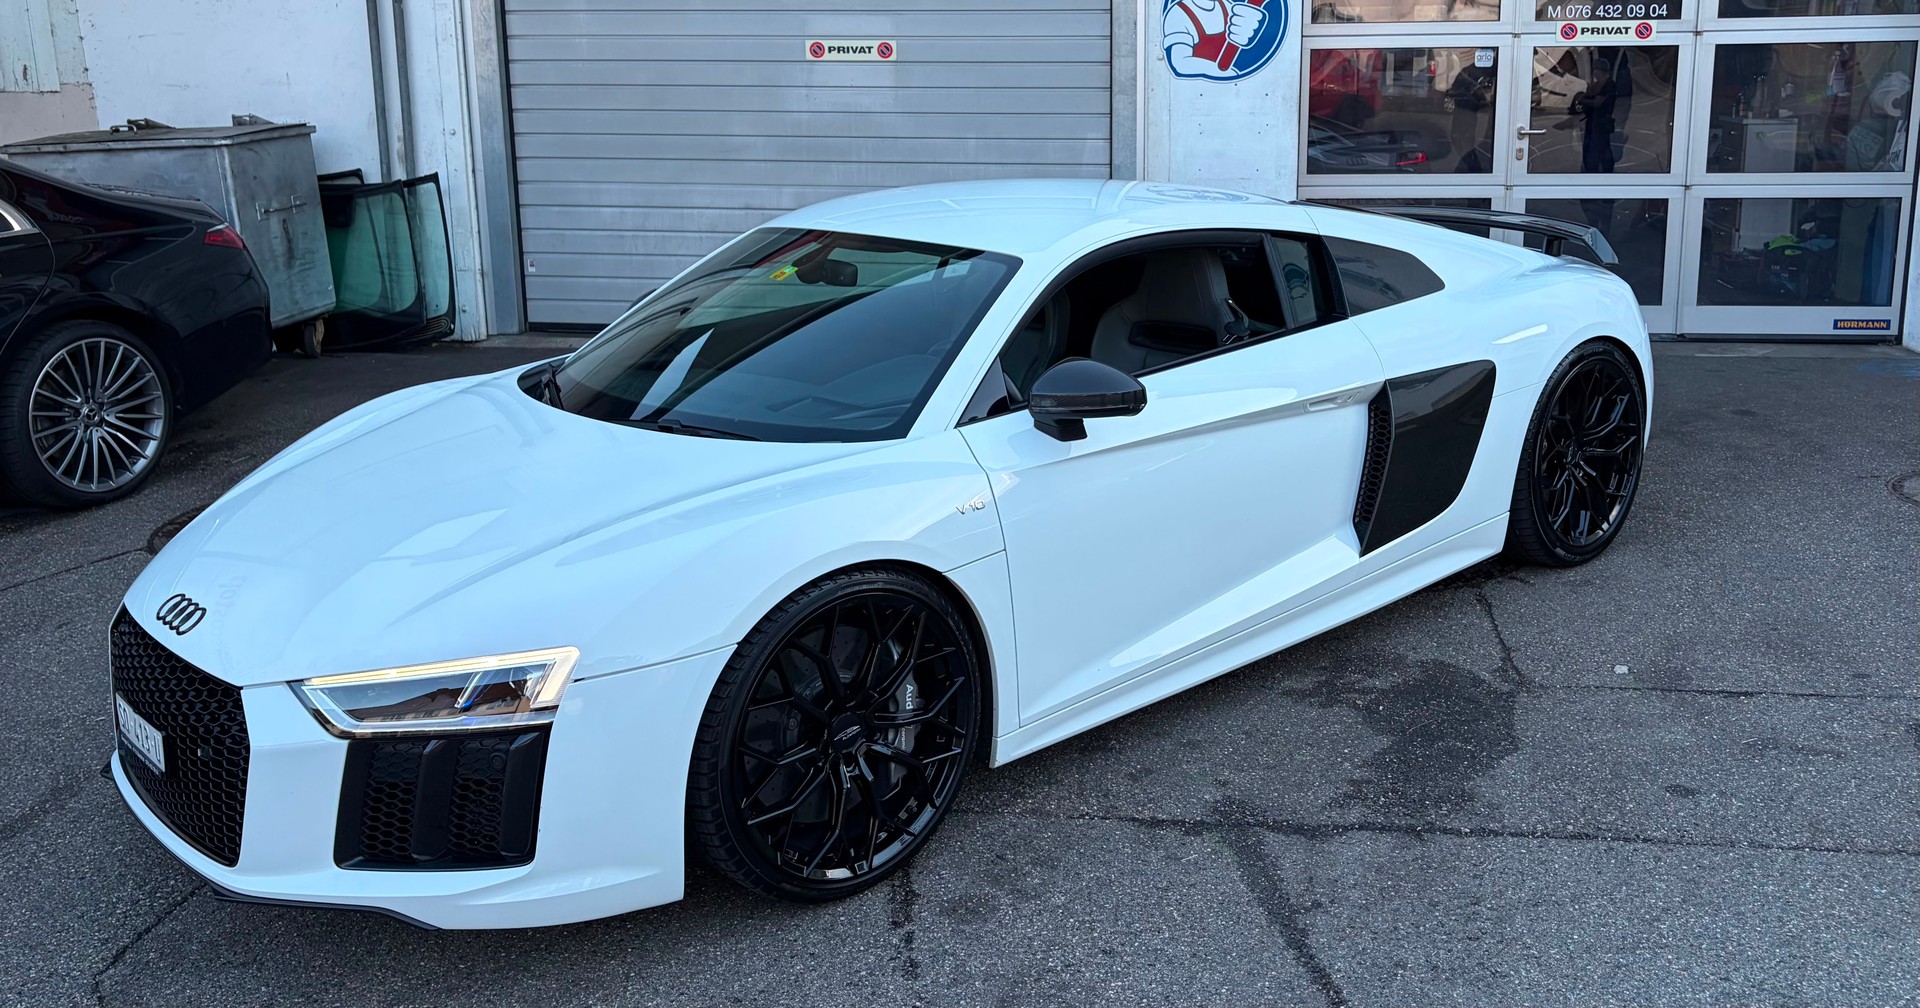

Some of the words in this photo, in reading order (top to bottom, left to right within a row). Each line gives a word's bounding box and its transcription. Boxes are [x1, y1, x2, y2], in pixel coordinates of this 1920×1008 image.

[1547, 5, 1561, 18] M
[1565, 5, 1592, 18] 076
[1595, 4, 1622, 18] 432
[1626, 4, 1645, 17] 09
[1649, 4, 1668, 17] 04
[1580, 26, 1631, 35] PRIVAT
[827, 46, 874, 54] PRIVAT
[1476, 53, 1492, 61] arlo
[955, 500, 986, 514] V10
[905, 684, 914, 710] Aud
